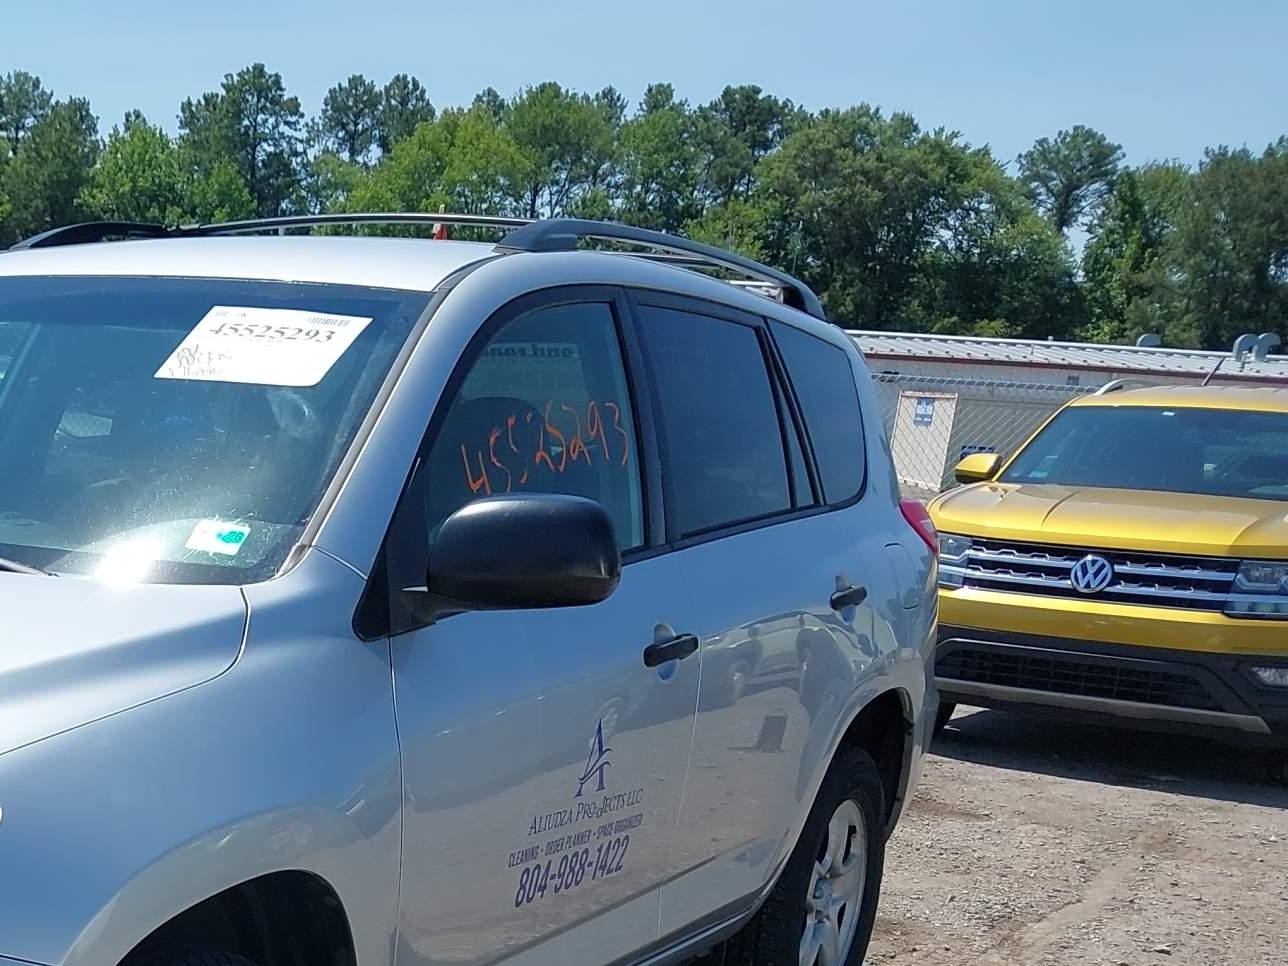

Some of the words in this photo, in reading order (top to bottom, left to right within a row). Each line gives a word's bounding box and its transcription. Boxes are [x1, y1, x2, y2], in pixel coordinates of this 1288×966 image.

[209, 322, 336, 343] 45525293
[626, 788, 644, 806] LLC
[514, 835, 630, 908] 804-988-1422
